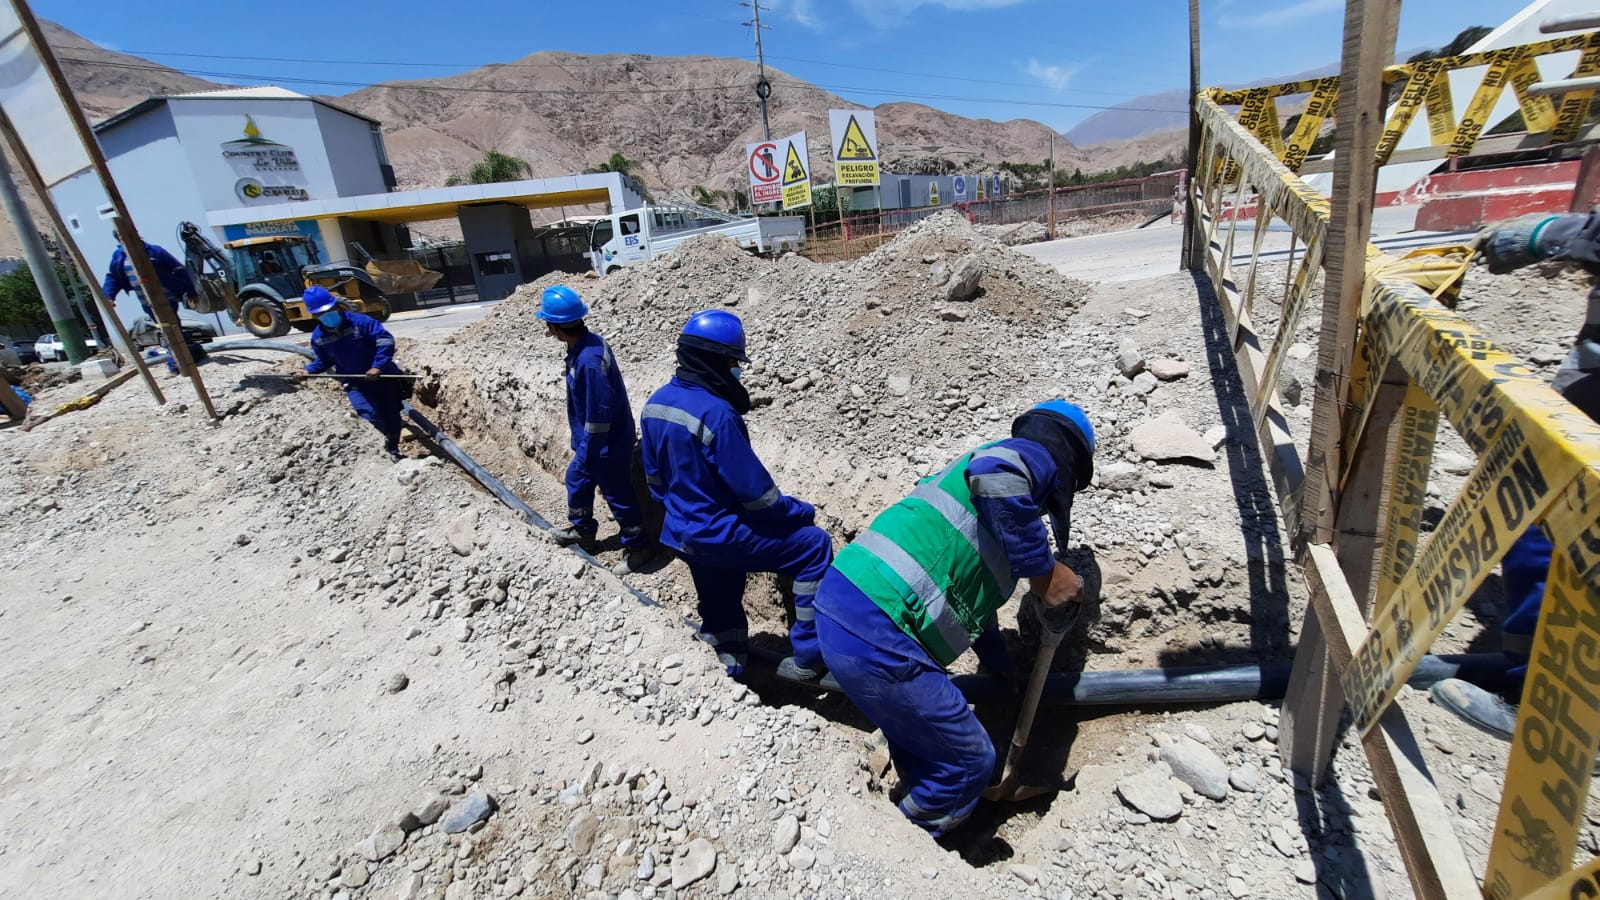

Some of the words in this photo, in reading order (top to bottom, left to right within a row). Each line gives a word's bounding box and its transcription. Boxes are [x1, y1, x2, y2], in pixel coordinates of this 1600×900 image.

[1484, 71, 1503, 88] NO
[245, 224, 300, 235] INMEDIATA
[1467, 418, 1525, 509] HOMBRES
[1497, 446, 1548, 531] NO
[1423, 507, 1498, 631] PASAR
